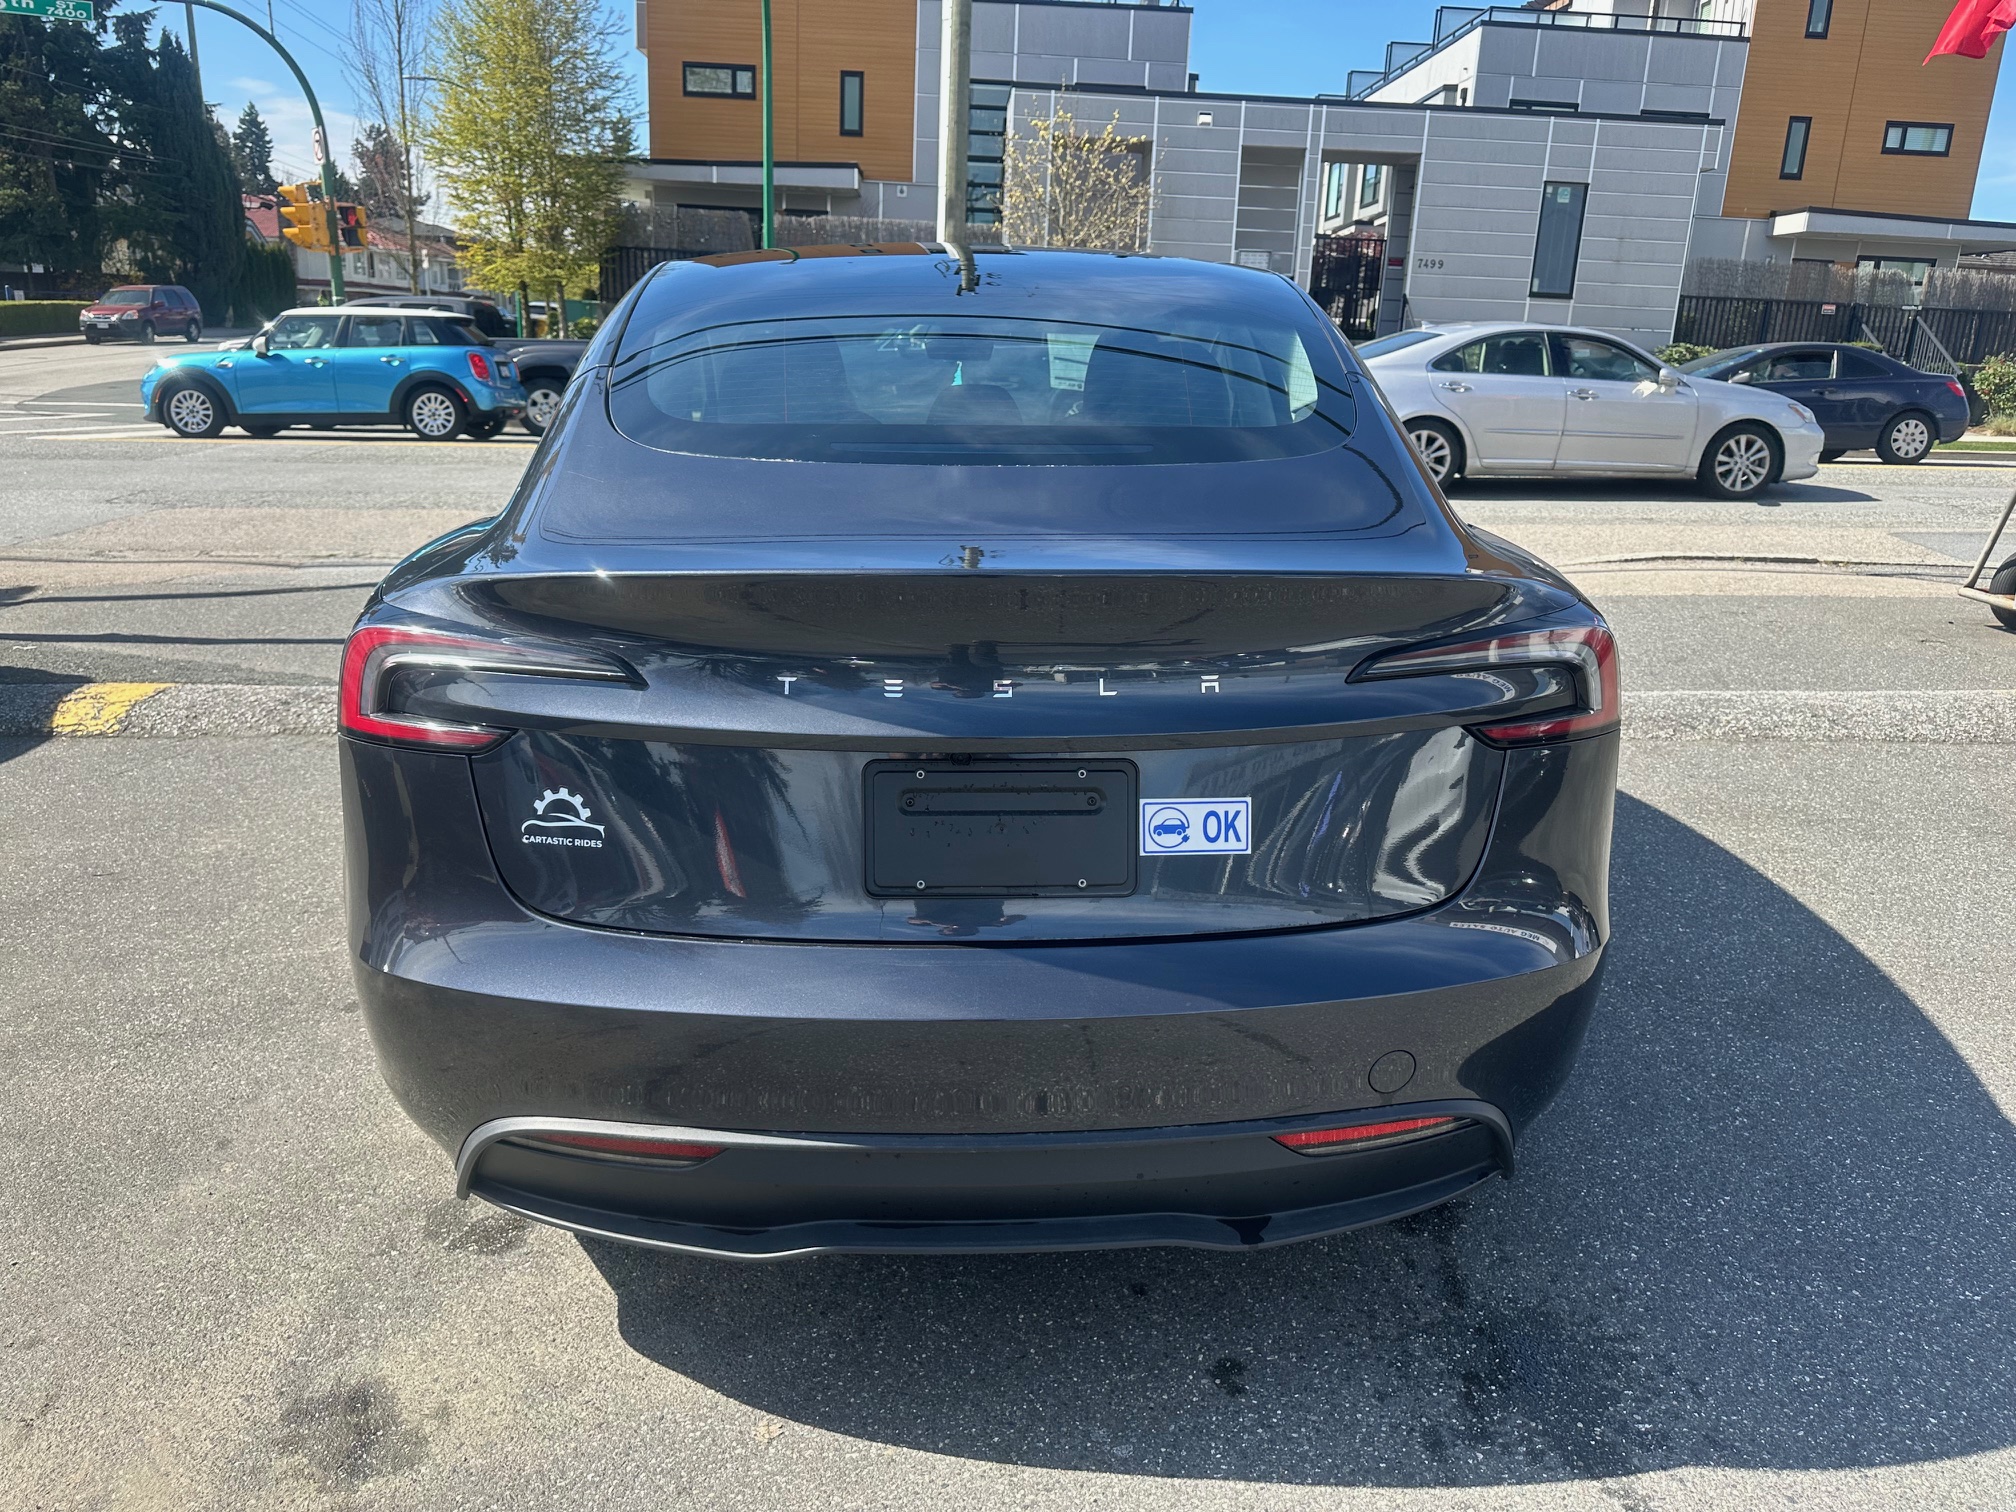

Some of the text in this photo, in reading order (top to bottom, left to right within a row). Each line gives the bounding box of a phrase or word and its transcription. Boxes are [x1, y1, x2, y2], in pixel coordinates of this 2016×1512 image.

[0, 0, 76, 9] th ST
[46, 7, 87, 18] 7400
[1417, 258, 1444, 269] 7499
[777, 675, 1220, 698] TESLA
[1202, 810, 1242, 843] OK
[522, 834, 603, 848] CARTASTIC RIDES
